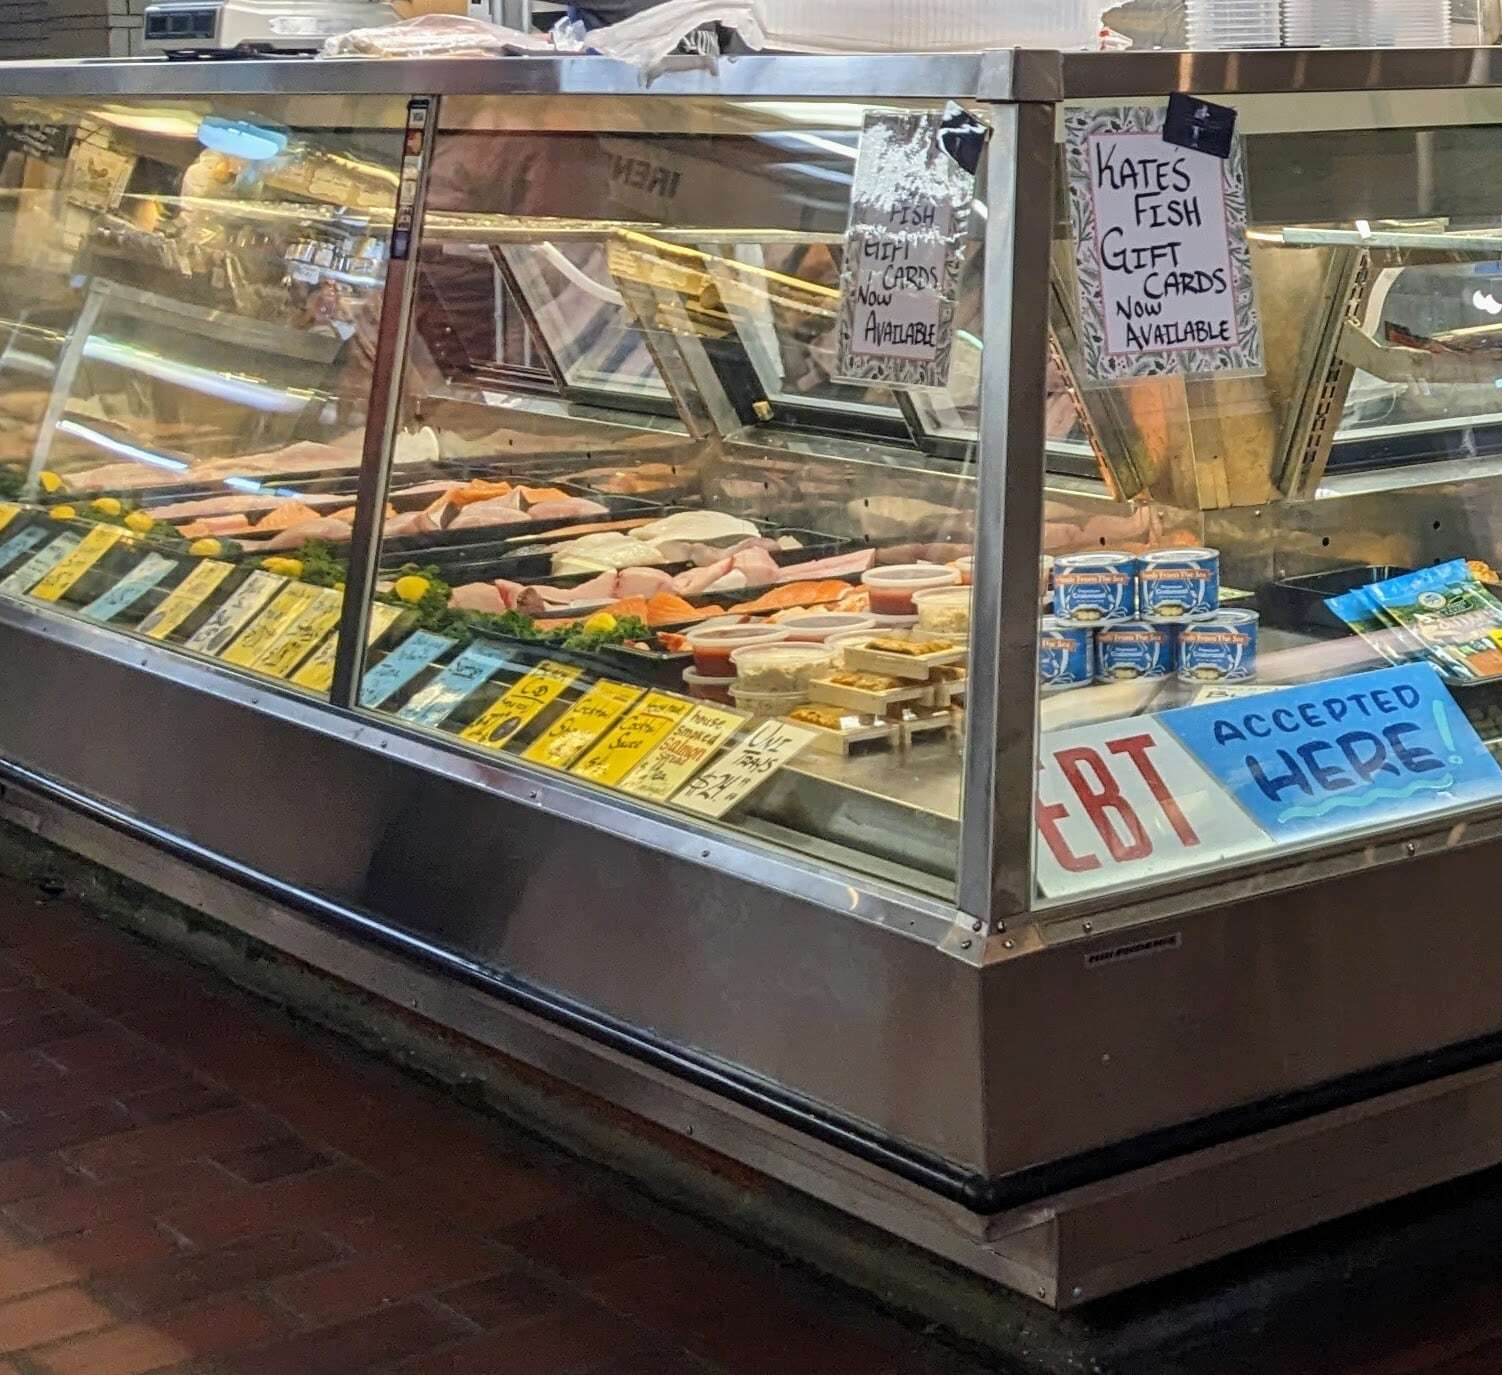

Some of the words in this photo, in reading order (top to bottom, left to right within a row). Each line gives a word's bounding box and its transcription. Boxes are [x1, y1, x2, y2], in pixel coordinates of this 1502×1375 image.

[1135, 191, 1202, 229] FISH
[1100, 226, 1182, 274] GIFT
[1143, 268, 1228, 300] CARDS
[1126, 318, 1232, 351] AVAILABLE
[1213, 684, 1421, 745] ACCEPTED
